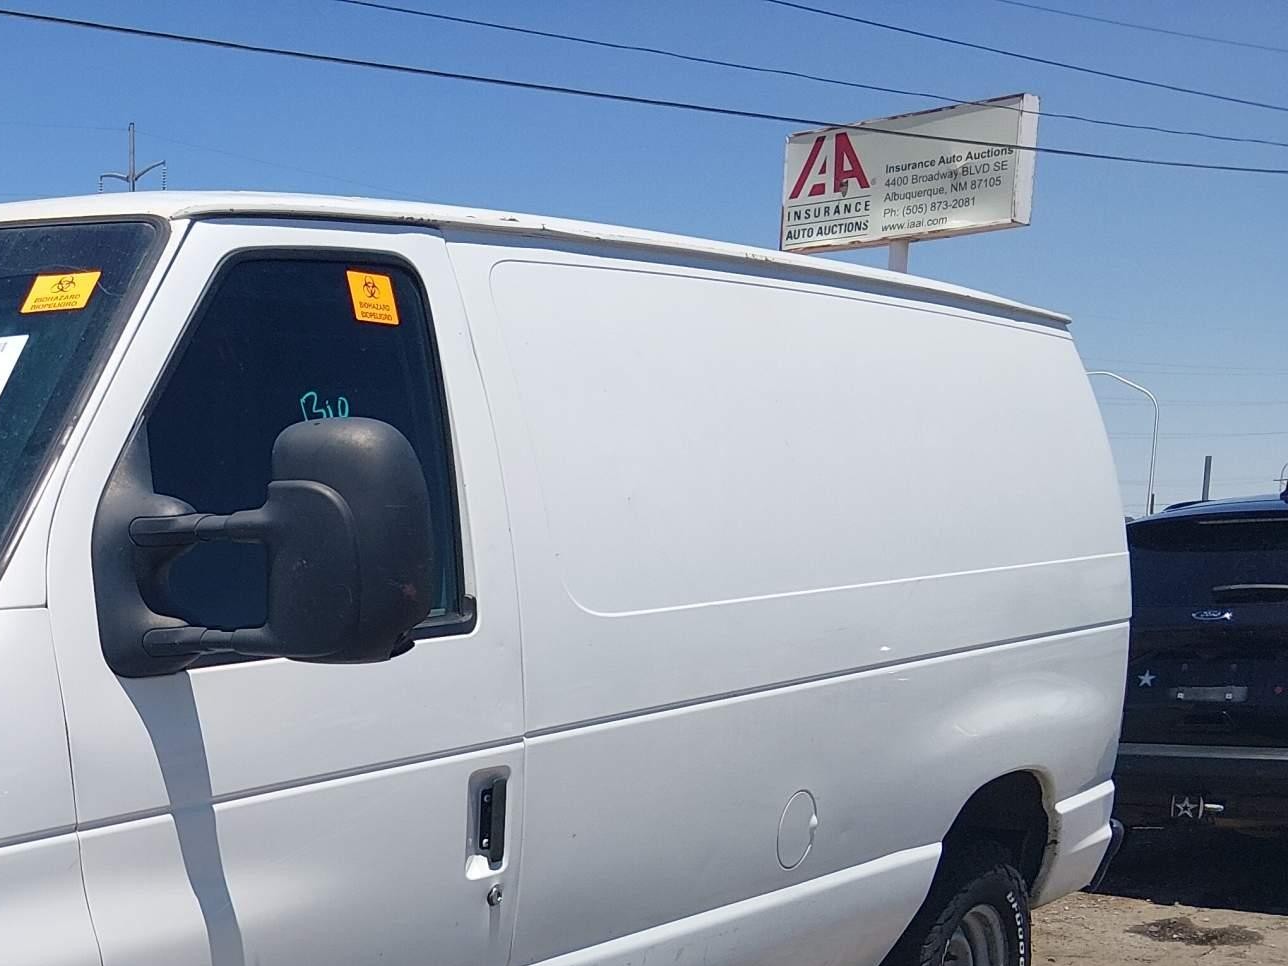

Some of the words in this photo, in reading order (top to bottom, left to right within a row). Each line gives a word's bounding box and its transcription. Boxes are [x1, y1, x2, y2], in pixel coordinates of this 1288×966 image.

[886, 159, 935, 174] Insurance
[938, 155, 963, 166] Auto
[965, 147, 1014, 161] Auctions
[884, 176, 909, 188] 4400
[911, 168, 959, 184] Broadway
[961, 163, 990, 176] BLVD
[993, 161, 1009, 171] SE
[884, 186, 948, 202] Albuquerque,
[950, 181, 968, 193] NM
[970, 176, 1002, 190] 87105
[787, 200, 871, 221] INSURANCE
[883, 208, 899, 218] Ph:
[902, 203, 928, 216] (505)
[930, 197, 976, 212] 873-2081
[786, 227, 814, 241] AUTO
[816, 220, 869, 237] AUCTIONS
[881, 216, 948, 232] www.iaai.com
